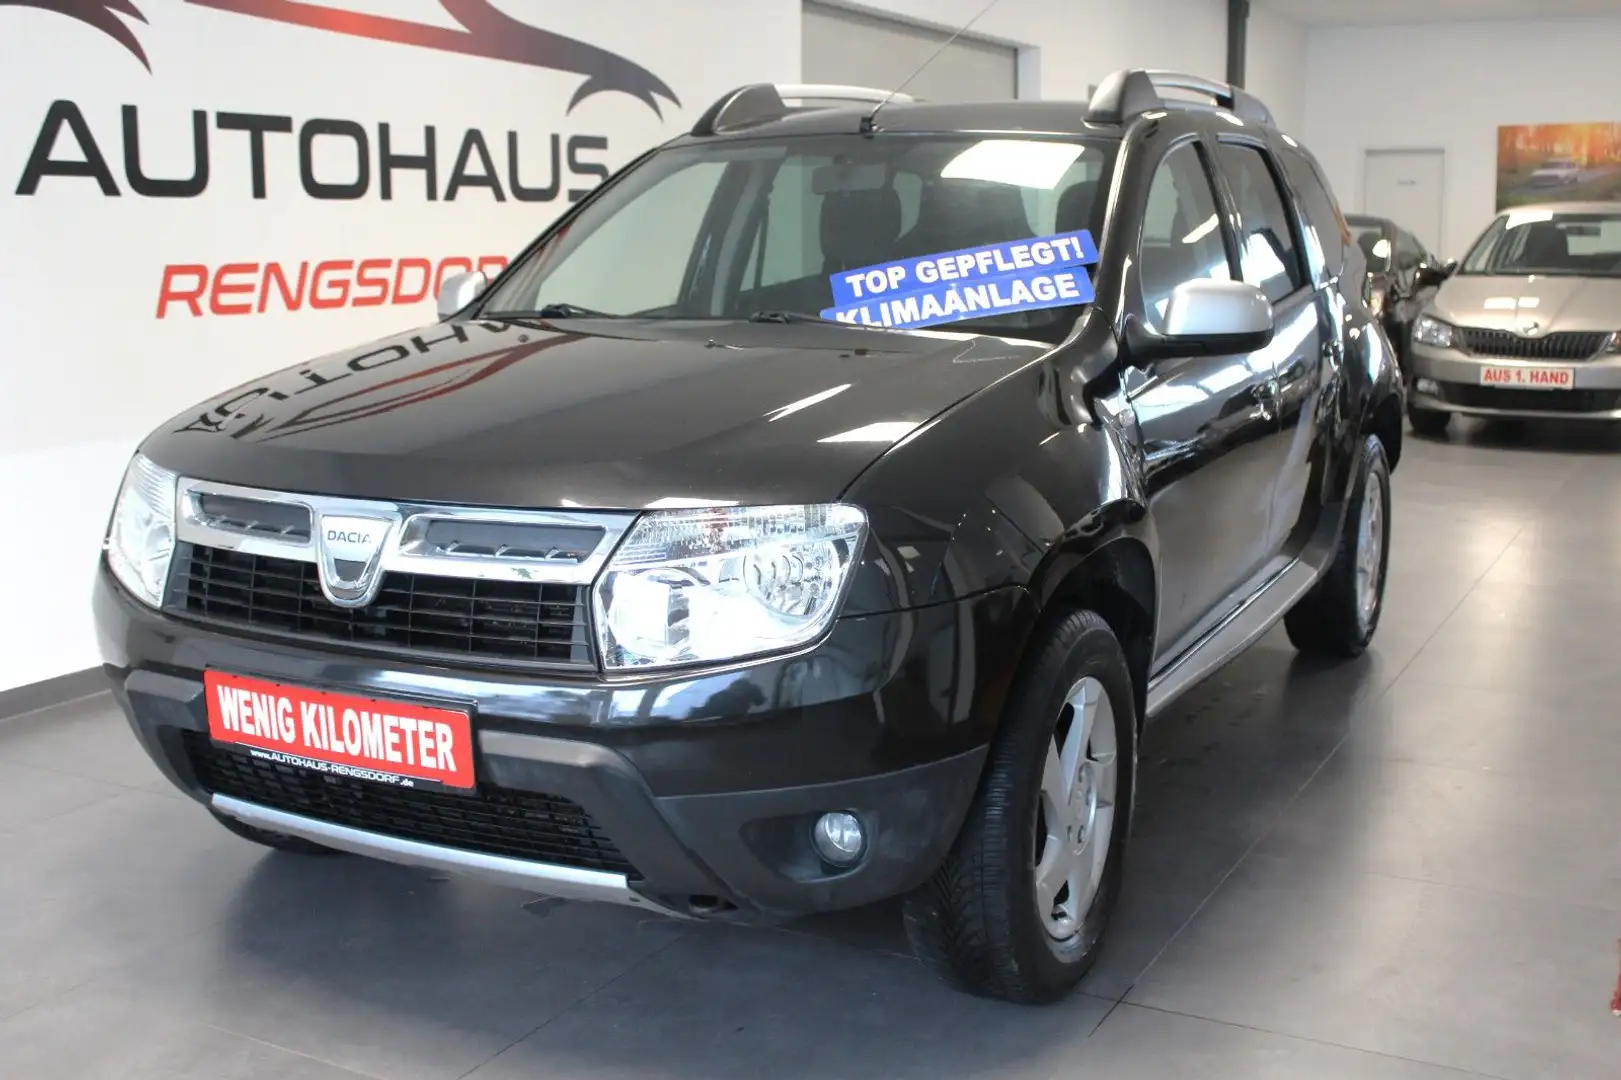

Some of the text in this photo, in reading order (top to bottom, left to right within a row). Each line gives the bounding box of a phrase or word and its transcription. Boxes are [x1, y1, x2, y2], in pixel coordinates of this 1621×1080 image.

[15, 100, 609, 203] AUTOHAUS
[845, 236, 1085, 297] TOP GEPFLEGT!
[835, 273, 1081, 328] KLIMAANLAGE
[1484, 368, 1511, 382] AUS
[1530, 371, 1569, 384] HAND
[327, 530, 372, 544] DACIA
[216, 685, 457, 772] WENIG KILOMETER
